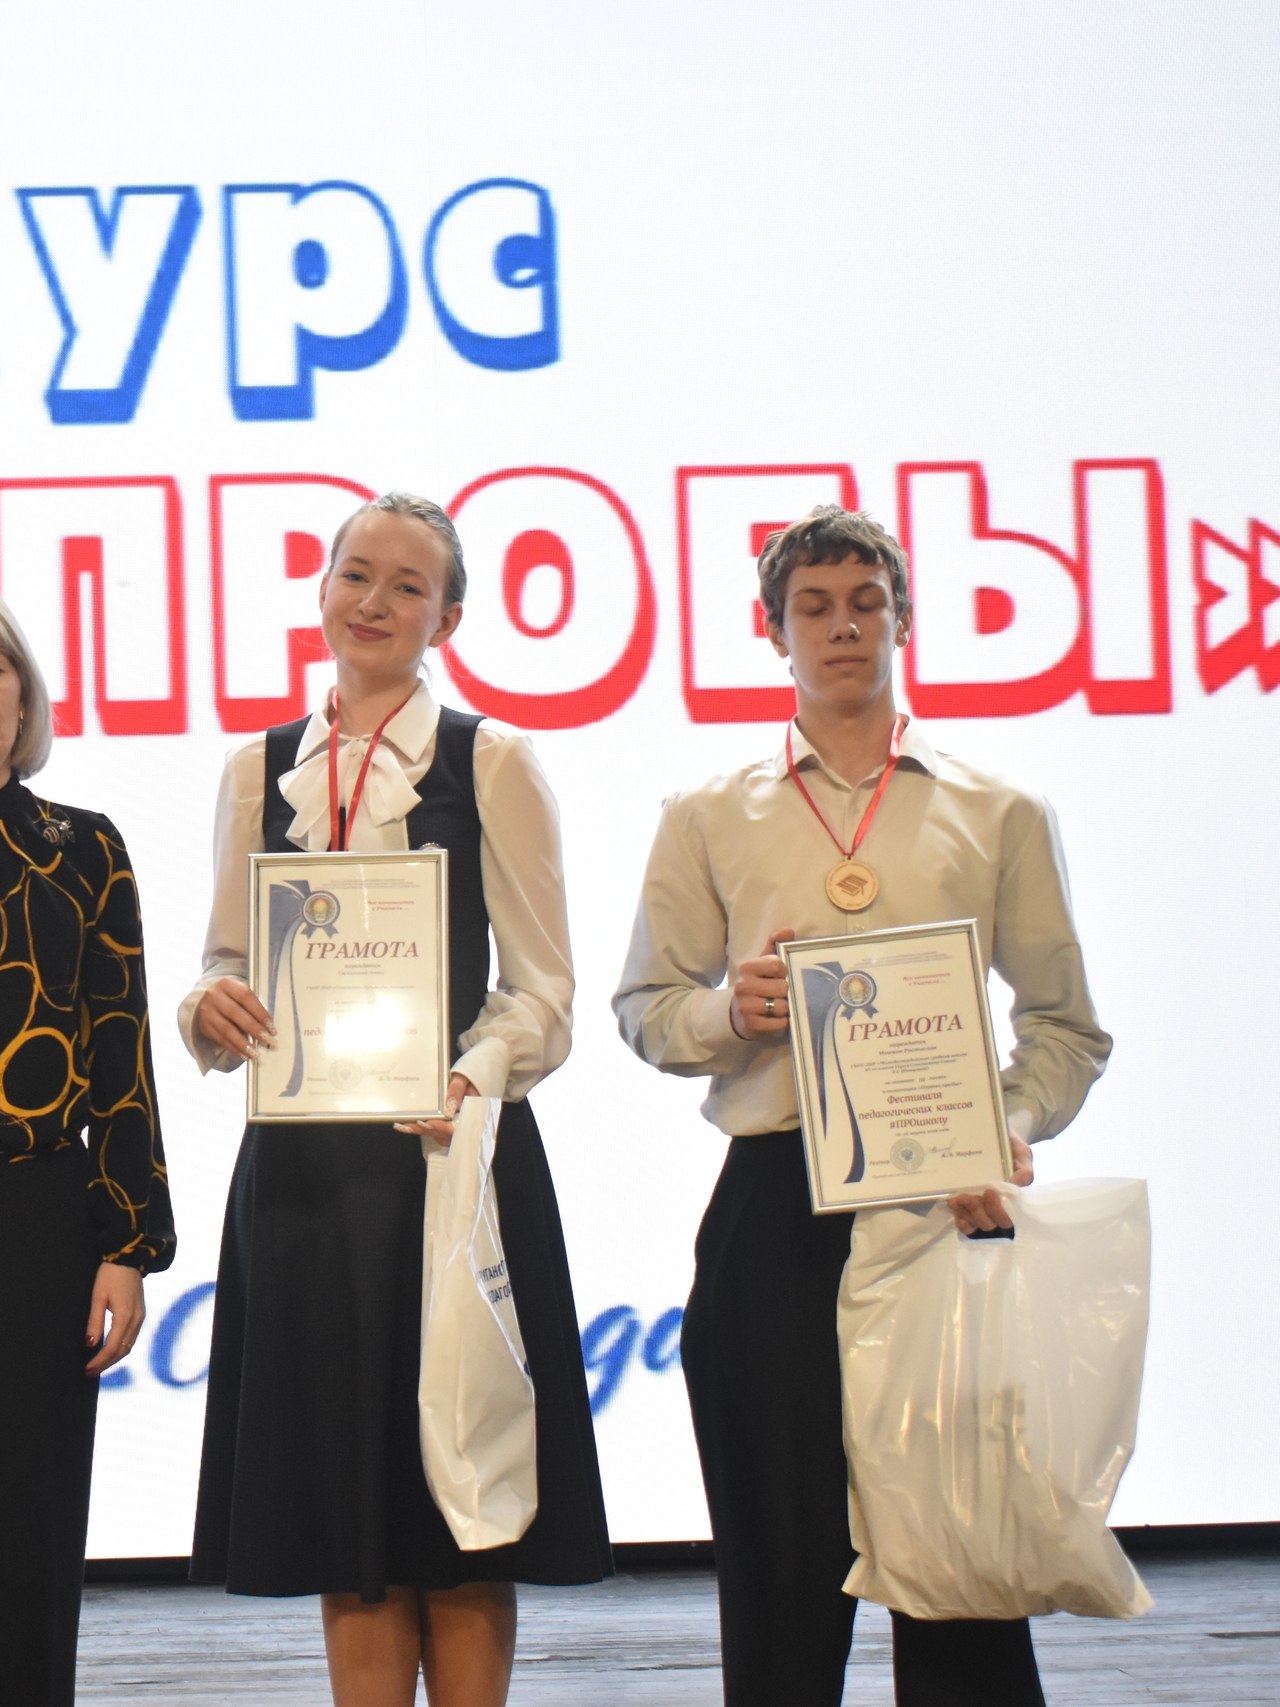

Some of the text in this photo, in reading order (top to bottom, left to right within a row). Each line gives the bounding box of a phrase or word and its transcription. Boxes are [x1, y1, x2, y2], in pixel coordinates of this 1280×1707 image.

[305, 941, 419, 960] ГРАМОТА
[848, 1013, 964, 1042] ГРАМОТА
[886, 1091, 943, 1105] Фестиваля
[858, 1101, 974, 1120] педагогических классов
[889, 1116, 948, 1129] #ПРОшколу
